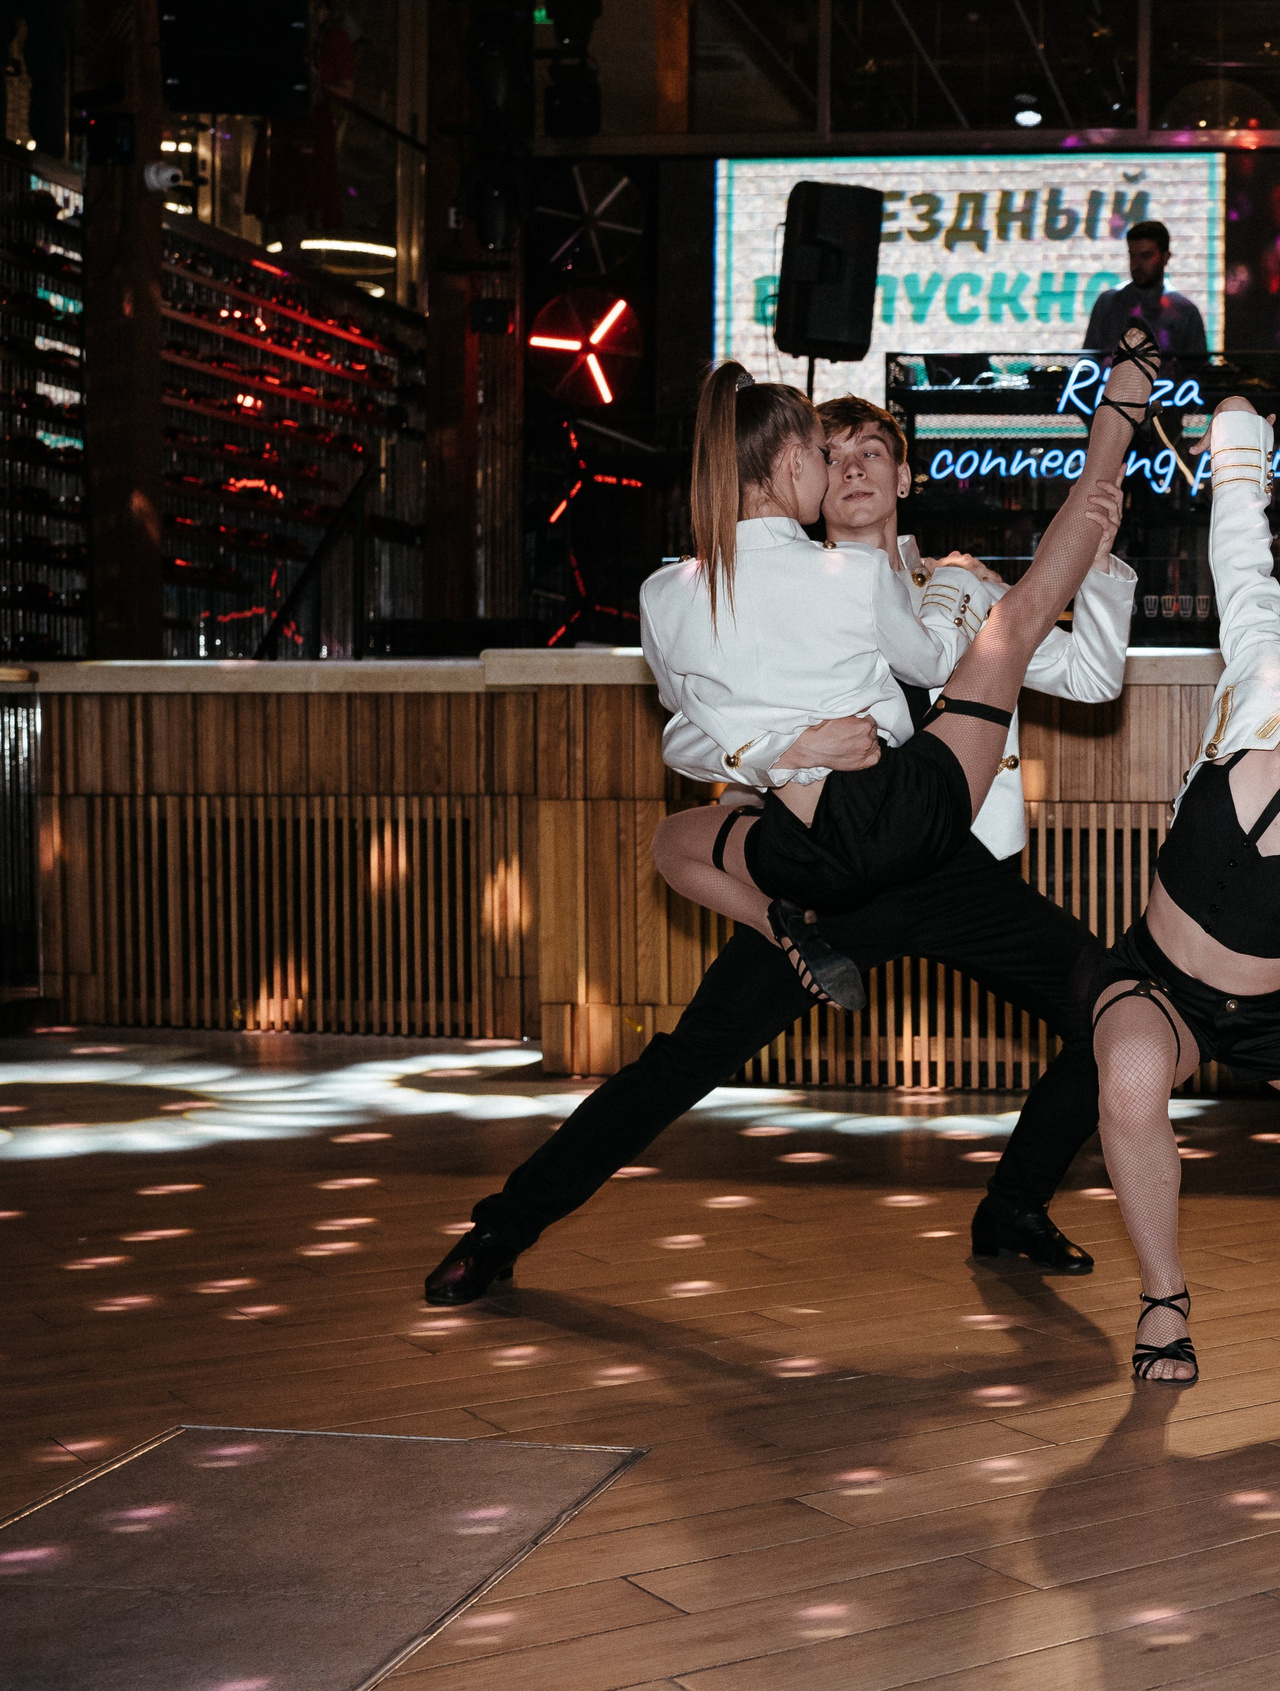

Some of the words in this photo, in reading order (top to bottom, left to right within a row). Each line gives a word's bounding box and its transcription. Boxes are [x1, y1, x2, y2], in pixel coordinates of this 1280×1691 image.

[881, 168, 1151, 253] ЕЗДНЫЙ
[1056, 359, 1205, 416] Riza
[929, 448, 1177, 494] connecng
